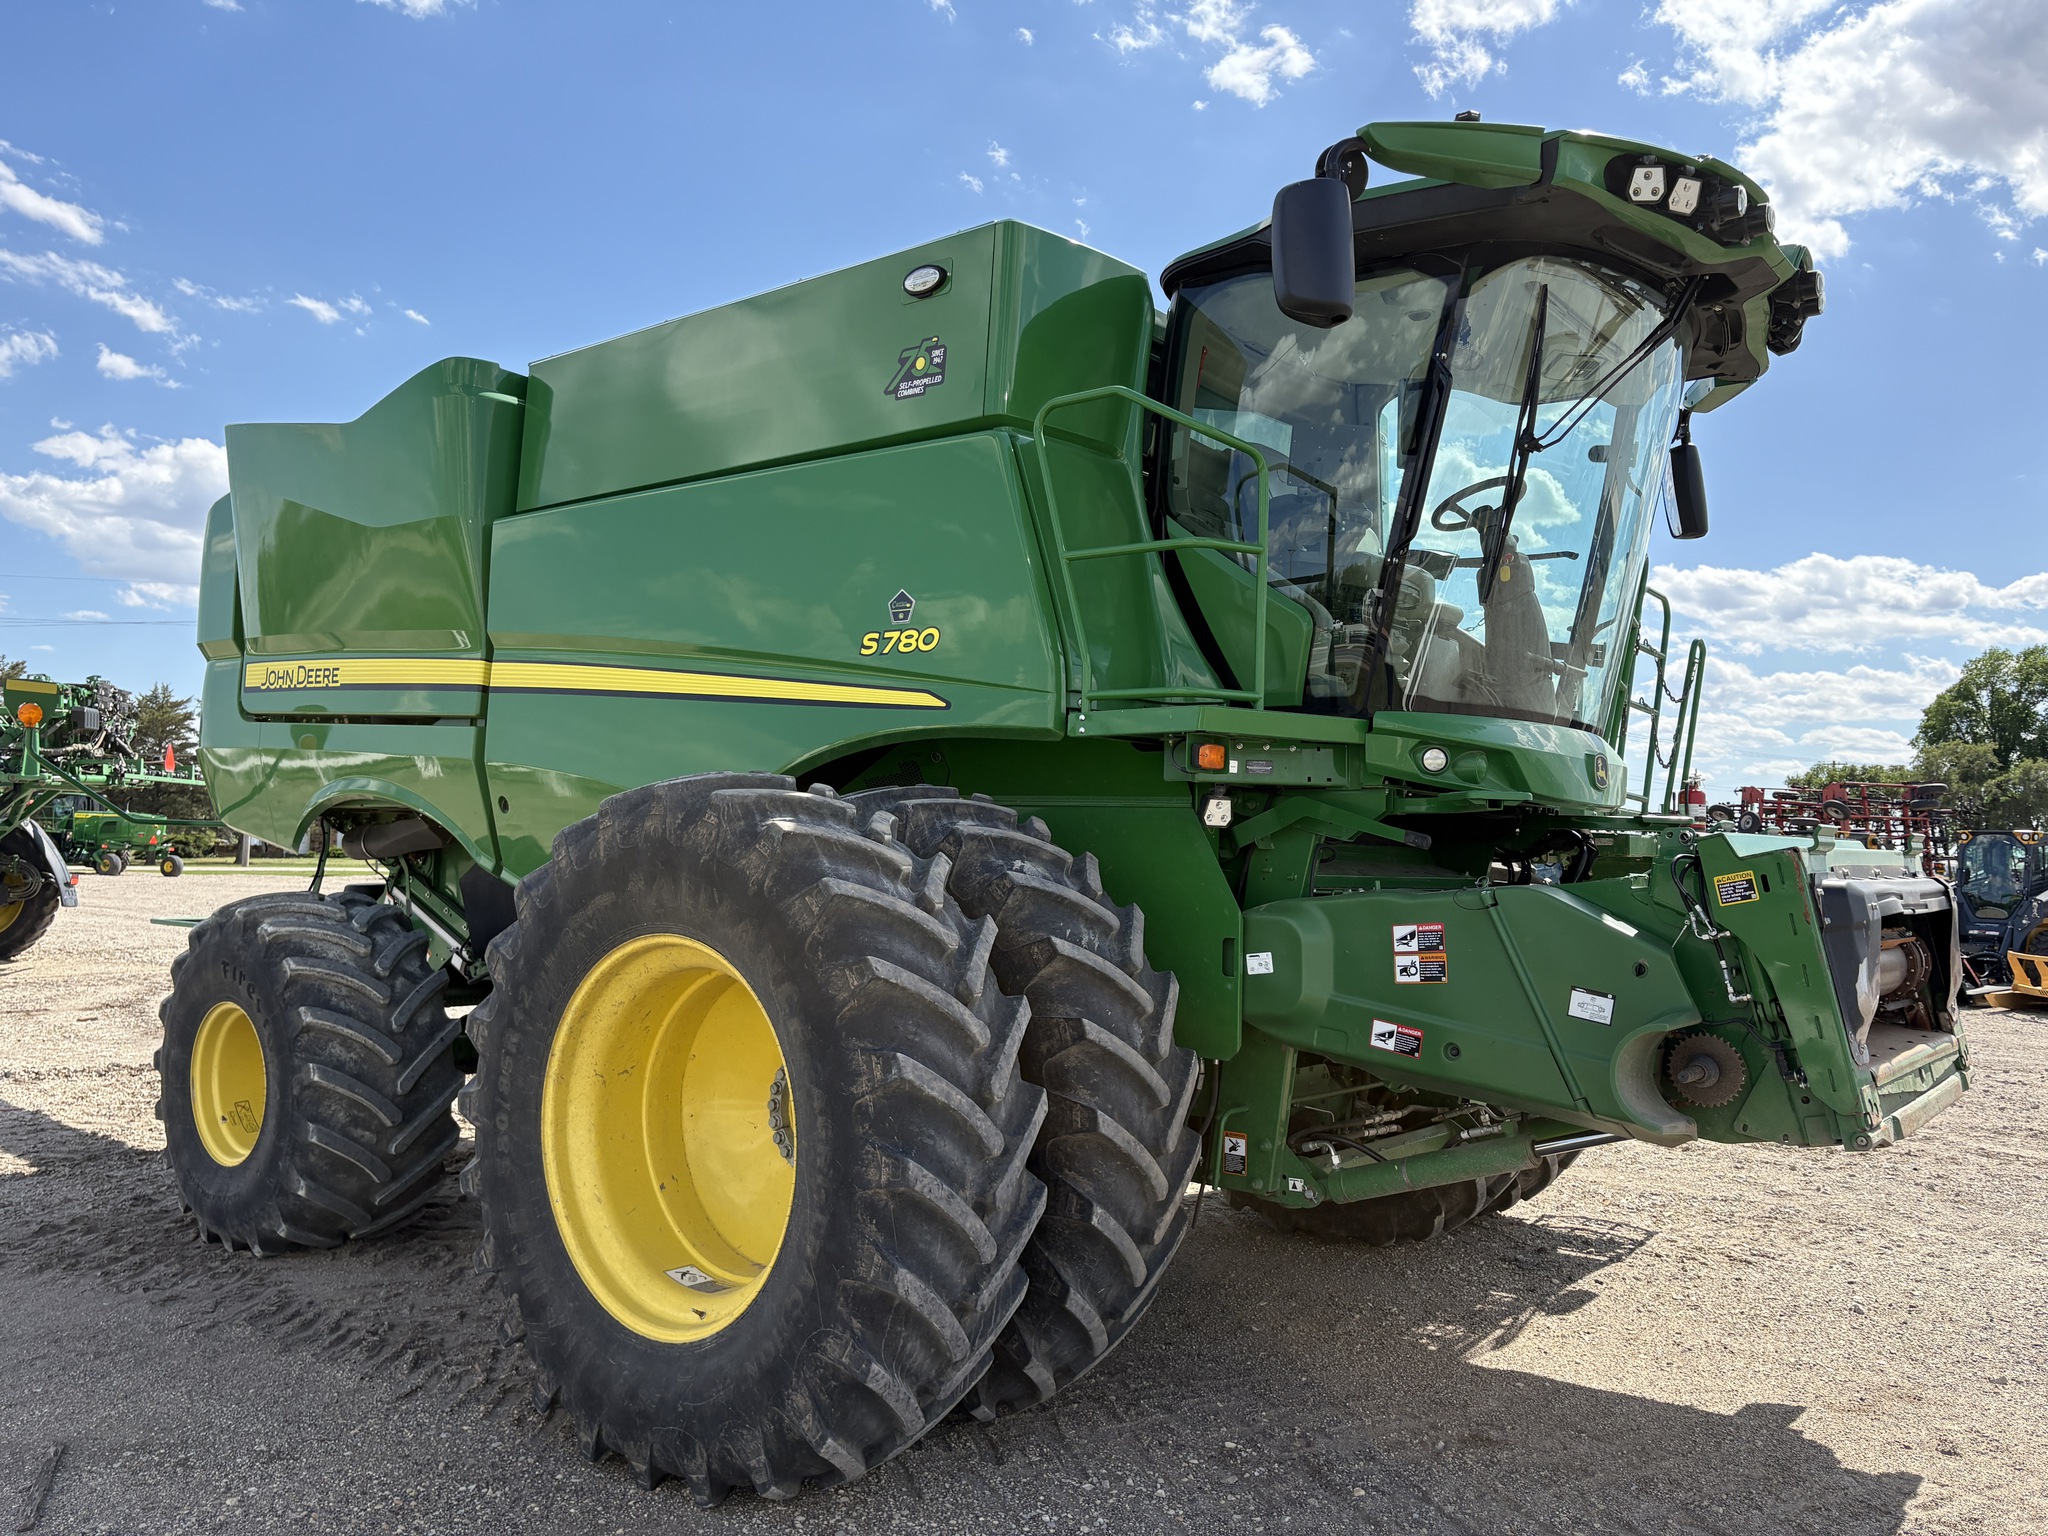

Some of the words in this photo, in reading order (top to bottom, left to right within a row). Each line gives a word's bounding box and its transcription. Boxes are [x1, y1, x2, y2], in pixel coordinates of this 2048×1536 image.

[931, 348, 944, 358] SINCE
[899, 374, 942, 390] SELF-PROPELLED
[897, 385, 925, 398] COMBINES
[860, 626, 940, 656] S780
[261, 667, 294, 687] JOHN
[296, 665, 340, 686] DEERE
[1721, 872, 1752, 882] CAUTION
[1401, 1028, 1422, 1037] DANGER
